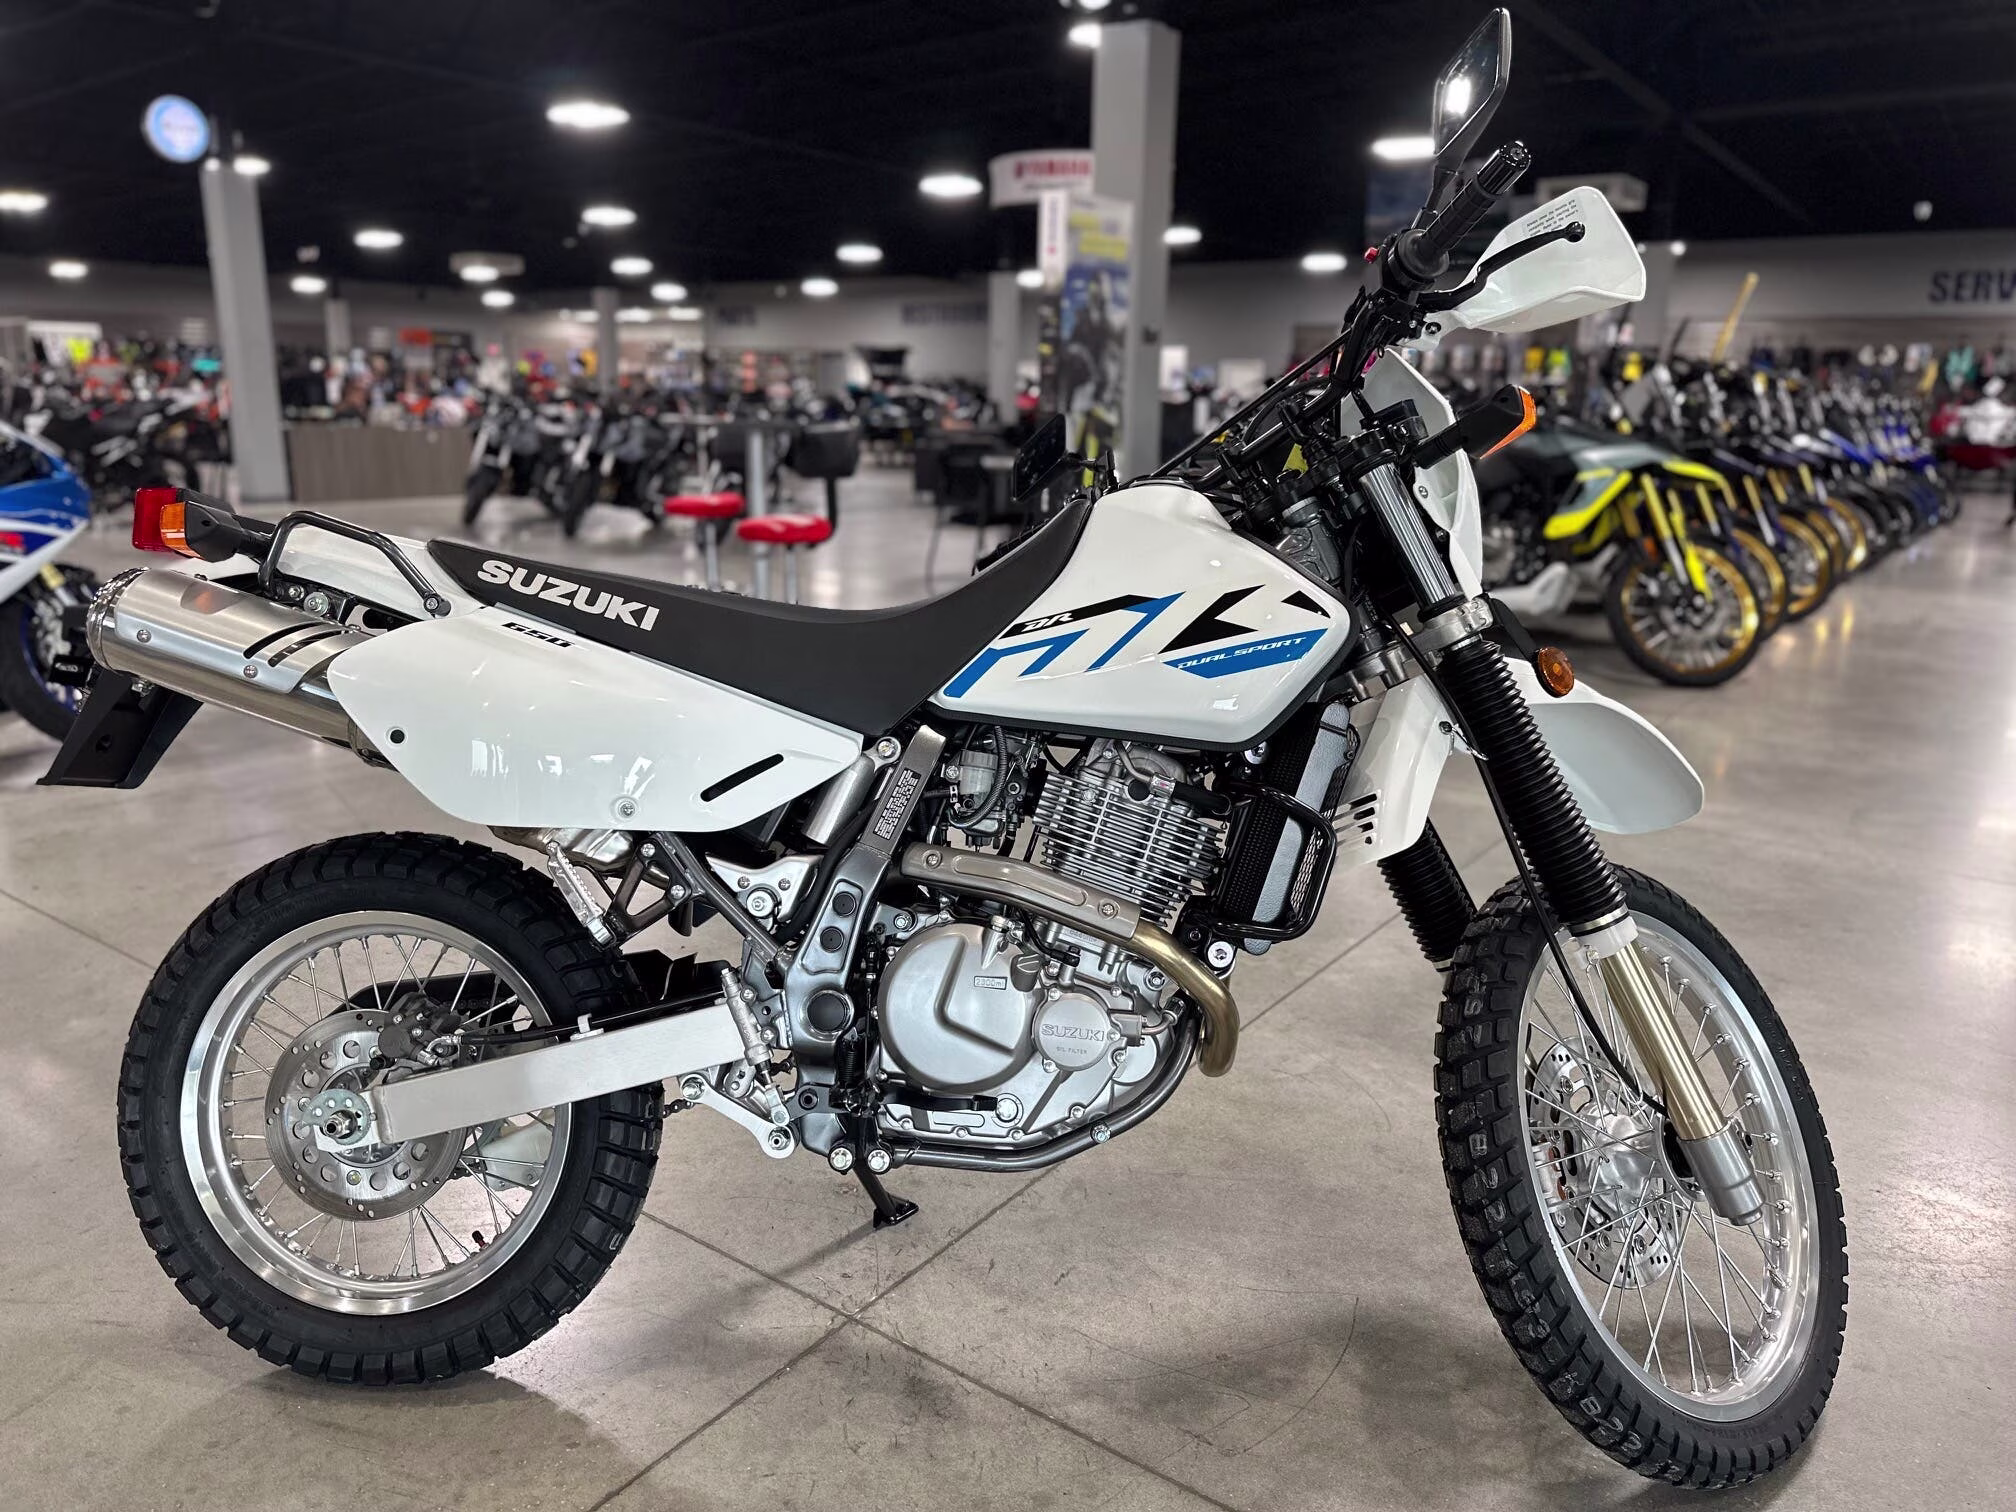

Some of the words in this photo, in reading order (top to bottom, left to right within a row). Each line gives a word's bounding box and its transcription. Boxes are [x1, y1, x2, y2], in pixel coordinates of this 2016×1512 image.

[477, 559, 660, 631] SUZUKI
[501, 621, 575, 648] 650
[1021, 612, 1074, 632] DR
[1177, 652, 1232, 669] DUAL
[1232, 636, 1307, 657] SPORT
[1041, 1023, 1105, 1042] SUZUKI
